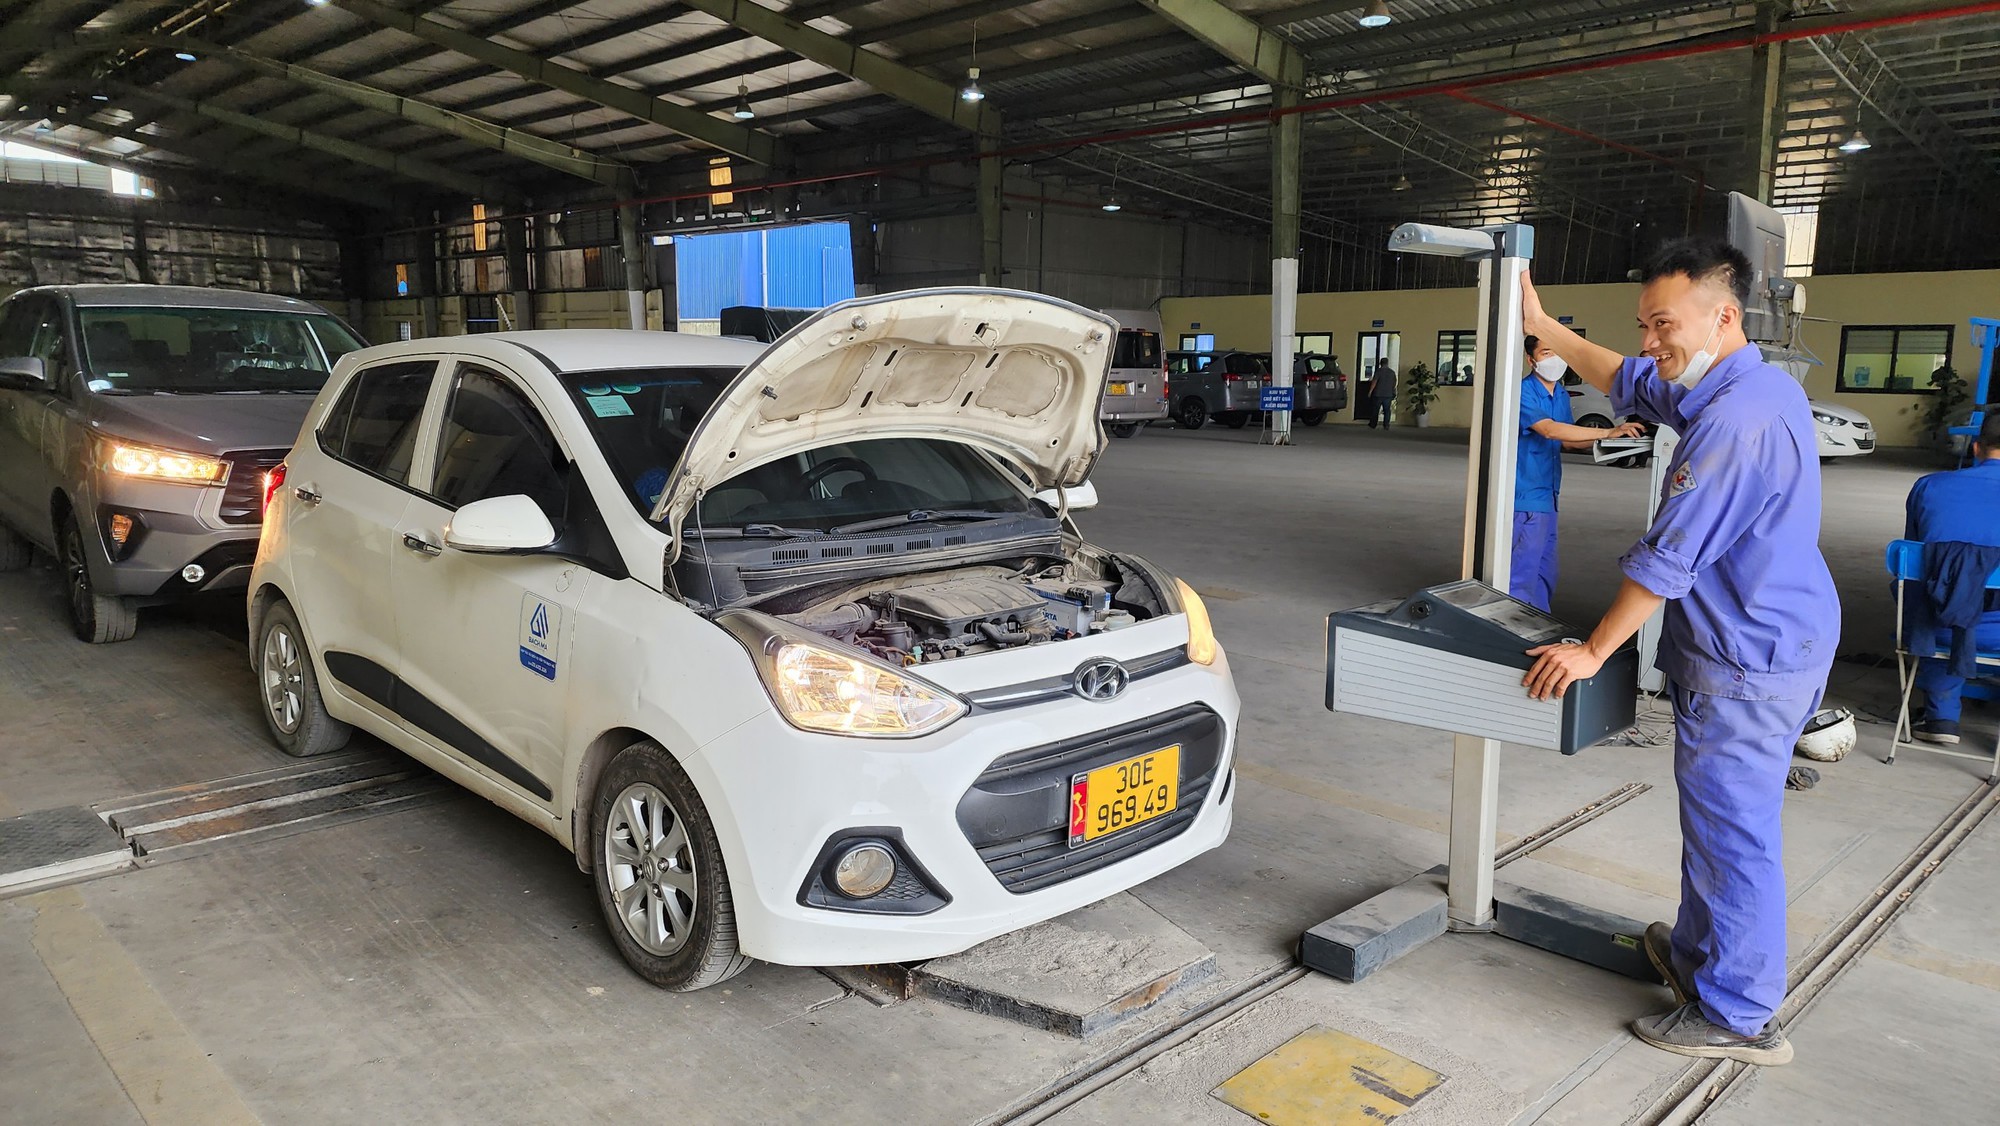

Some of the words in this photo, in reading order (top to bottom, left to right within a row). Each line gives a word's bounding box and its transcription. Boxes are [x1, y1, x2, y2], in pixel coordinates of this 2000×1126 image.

[1116, 756, 1154, 793] 30E
[1097, 784, 1168, 832] 969.49
[1072, 836, 1083, 844] VIE
